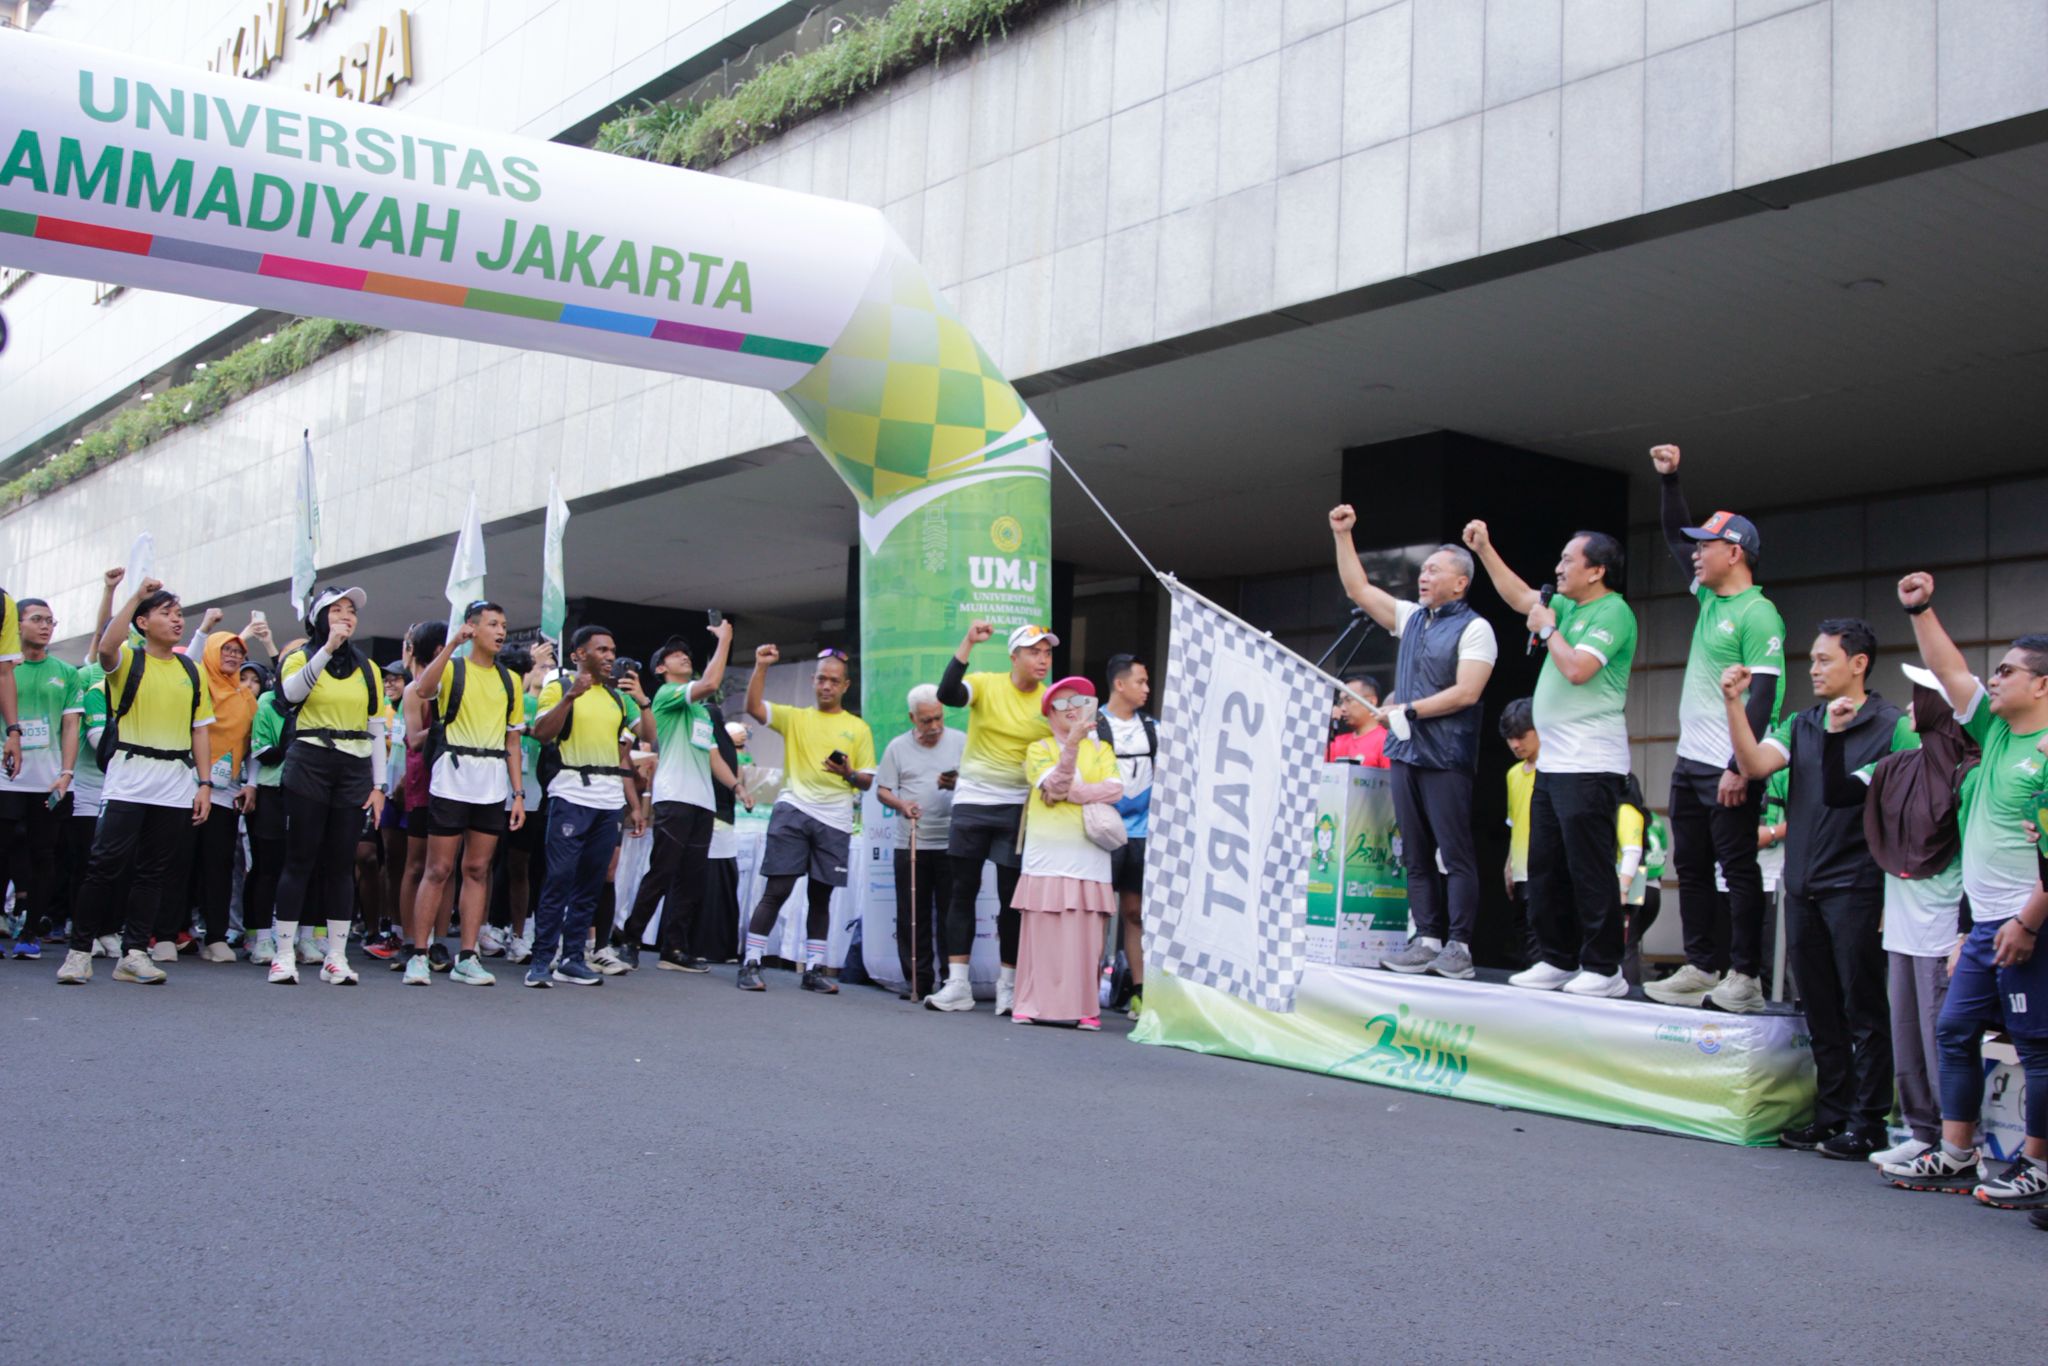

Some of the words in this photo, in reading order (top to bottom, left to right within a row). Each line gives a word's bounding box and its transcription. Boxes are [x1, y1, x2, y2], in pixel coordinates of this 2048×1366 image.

[78, 70, 542, 203] UNIVERSITAS
[476, 219, 754, 314] JAKARTA
[968, 556, 1037, 592] UMJ
[2008, 993, 2028, 1014] 10
[1386, 1044, 1469, 1087] RUN
